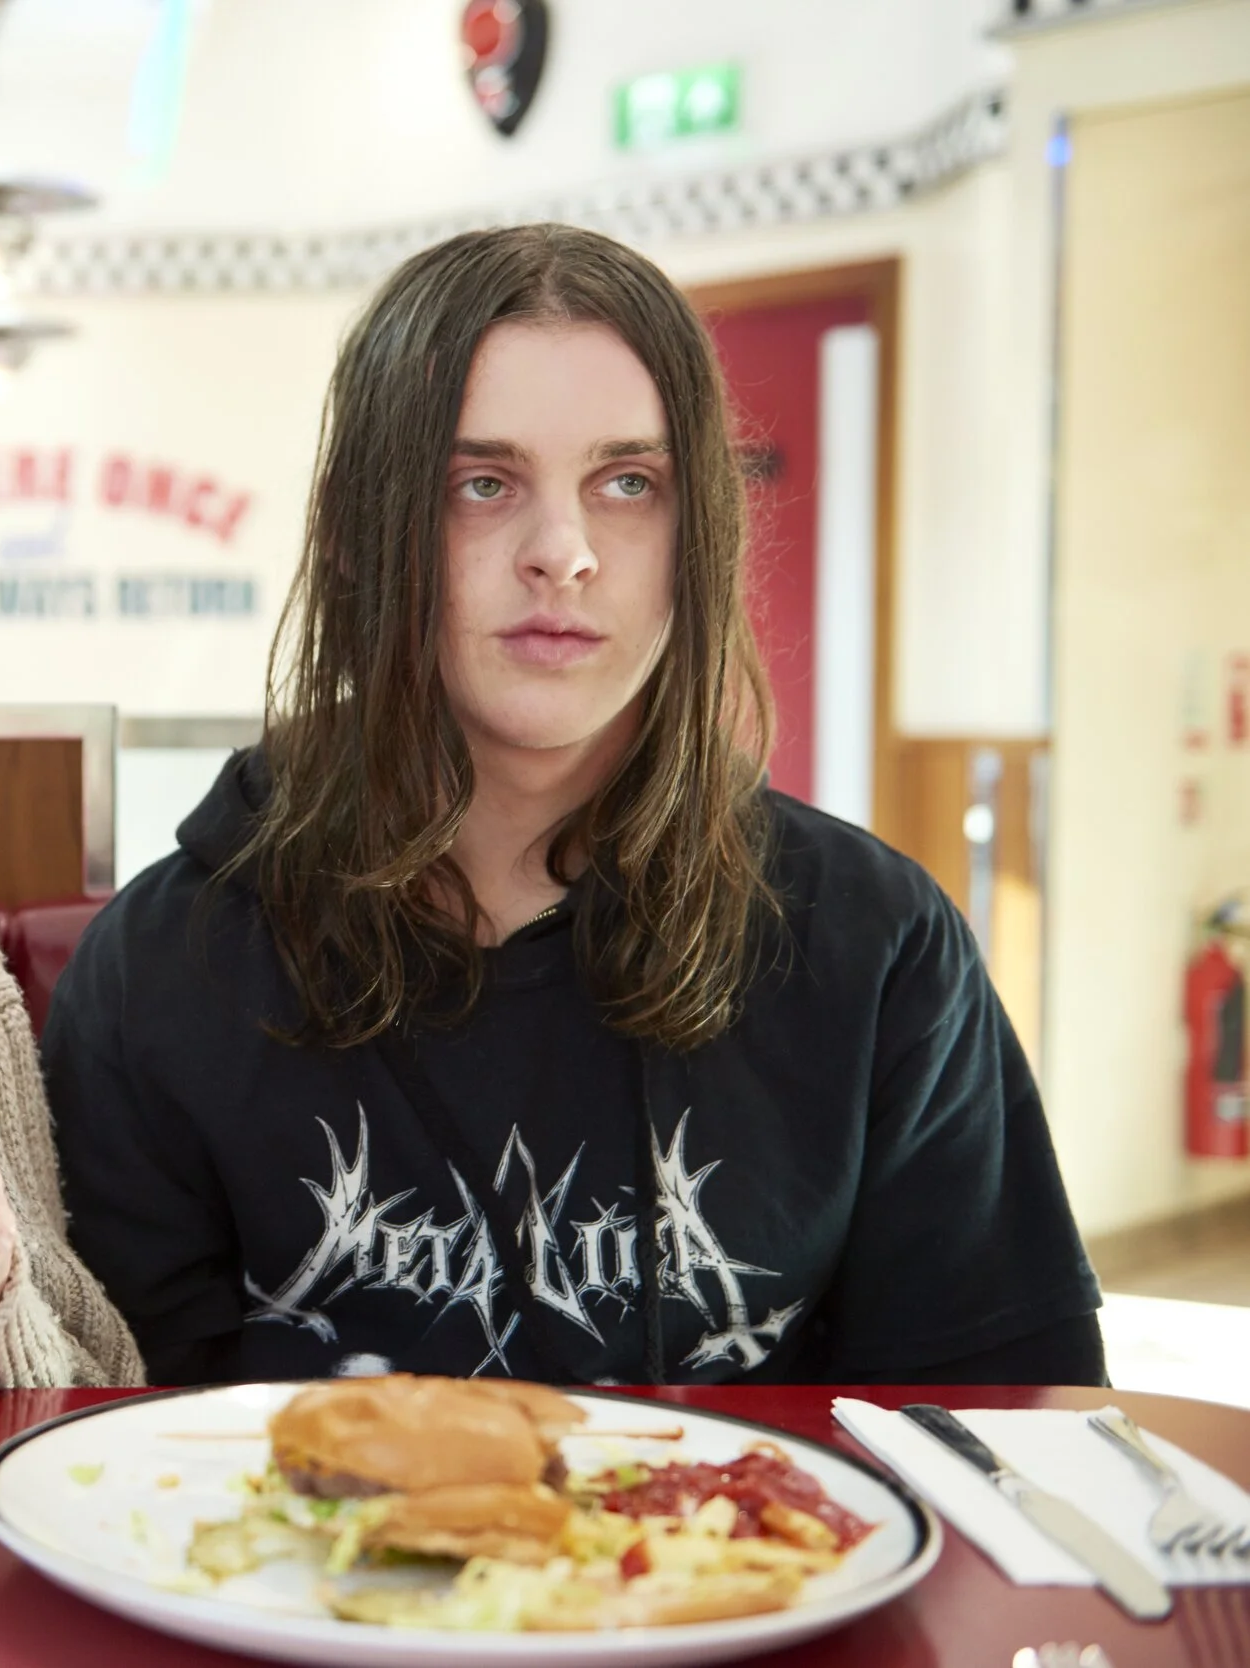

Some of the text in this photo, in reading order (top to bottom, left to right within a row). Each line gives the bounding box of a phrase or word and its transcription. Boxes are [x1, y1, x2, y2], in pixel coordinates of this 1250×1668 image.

[100, 450, 253, 546] ONCE
[117, 572, 255, 618] RETURN
[245, 1100, 804, 1376] METALICA
